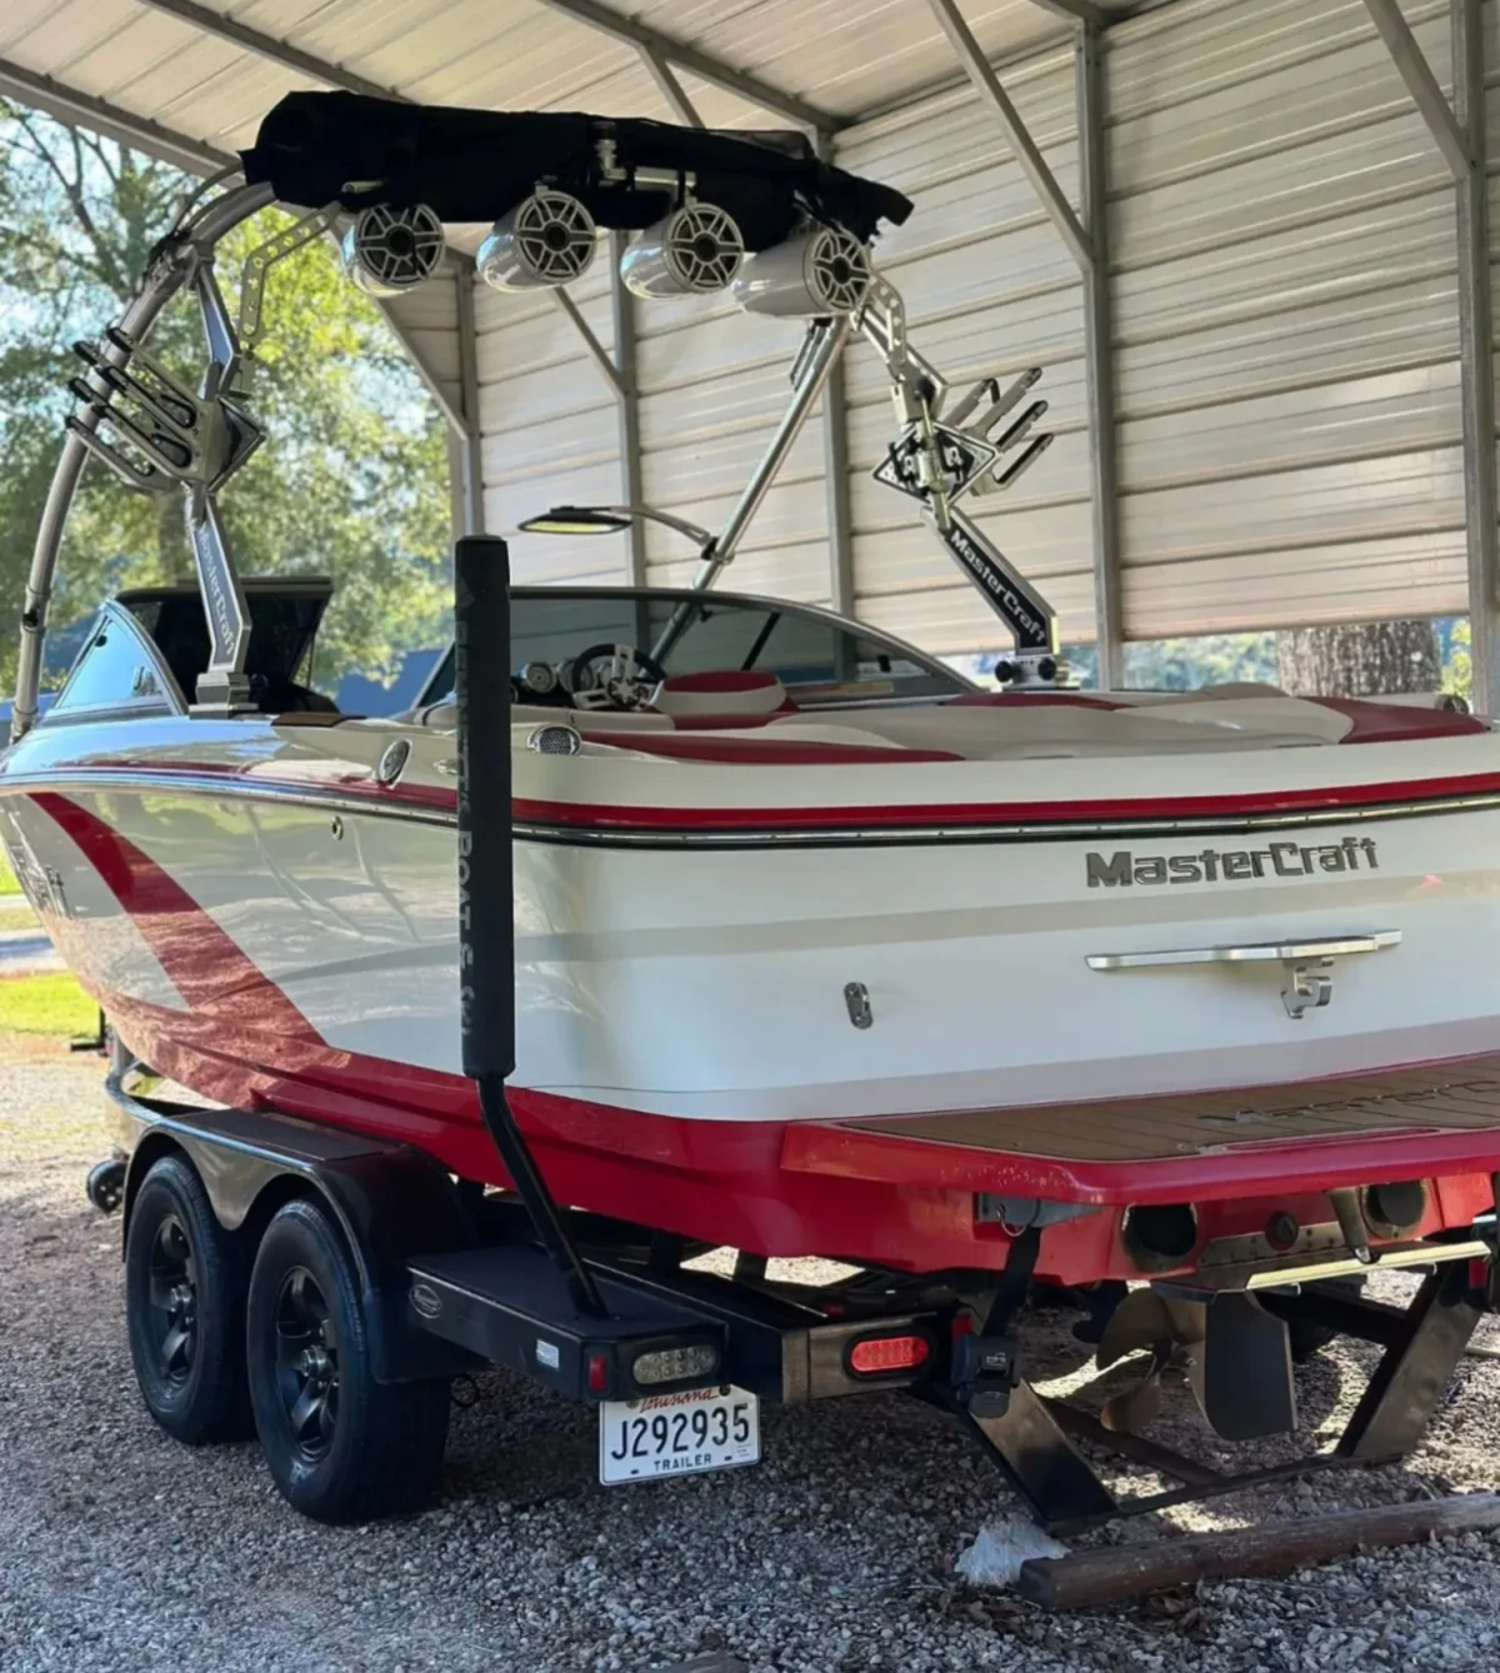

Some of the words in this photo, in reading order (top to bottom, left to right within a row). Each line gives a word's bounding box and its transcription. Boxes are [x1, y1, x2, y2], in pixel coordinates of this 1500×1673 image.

[950, 529, 1046, 643] MasterCraft
[457, 830, 472, 931] BOAT
[1085, 836, 1380, 889] MasterCraft
[640, 1387, 719, 1414] Louisiana
[610, 1402, 750, 1461] J292935
[653, 1452, 713, 1472] TRAILER
